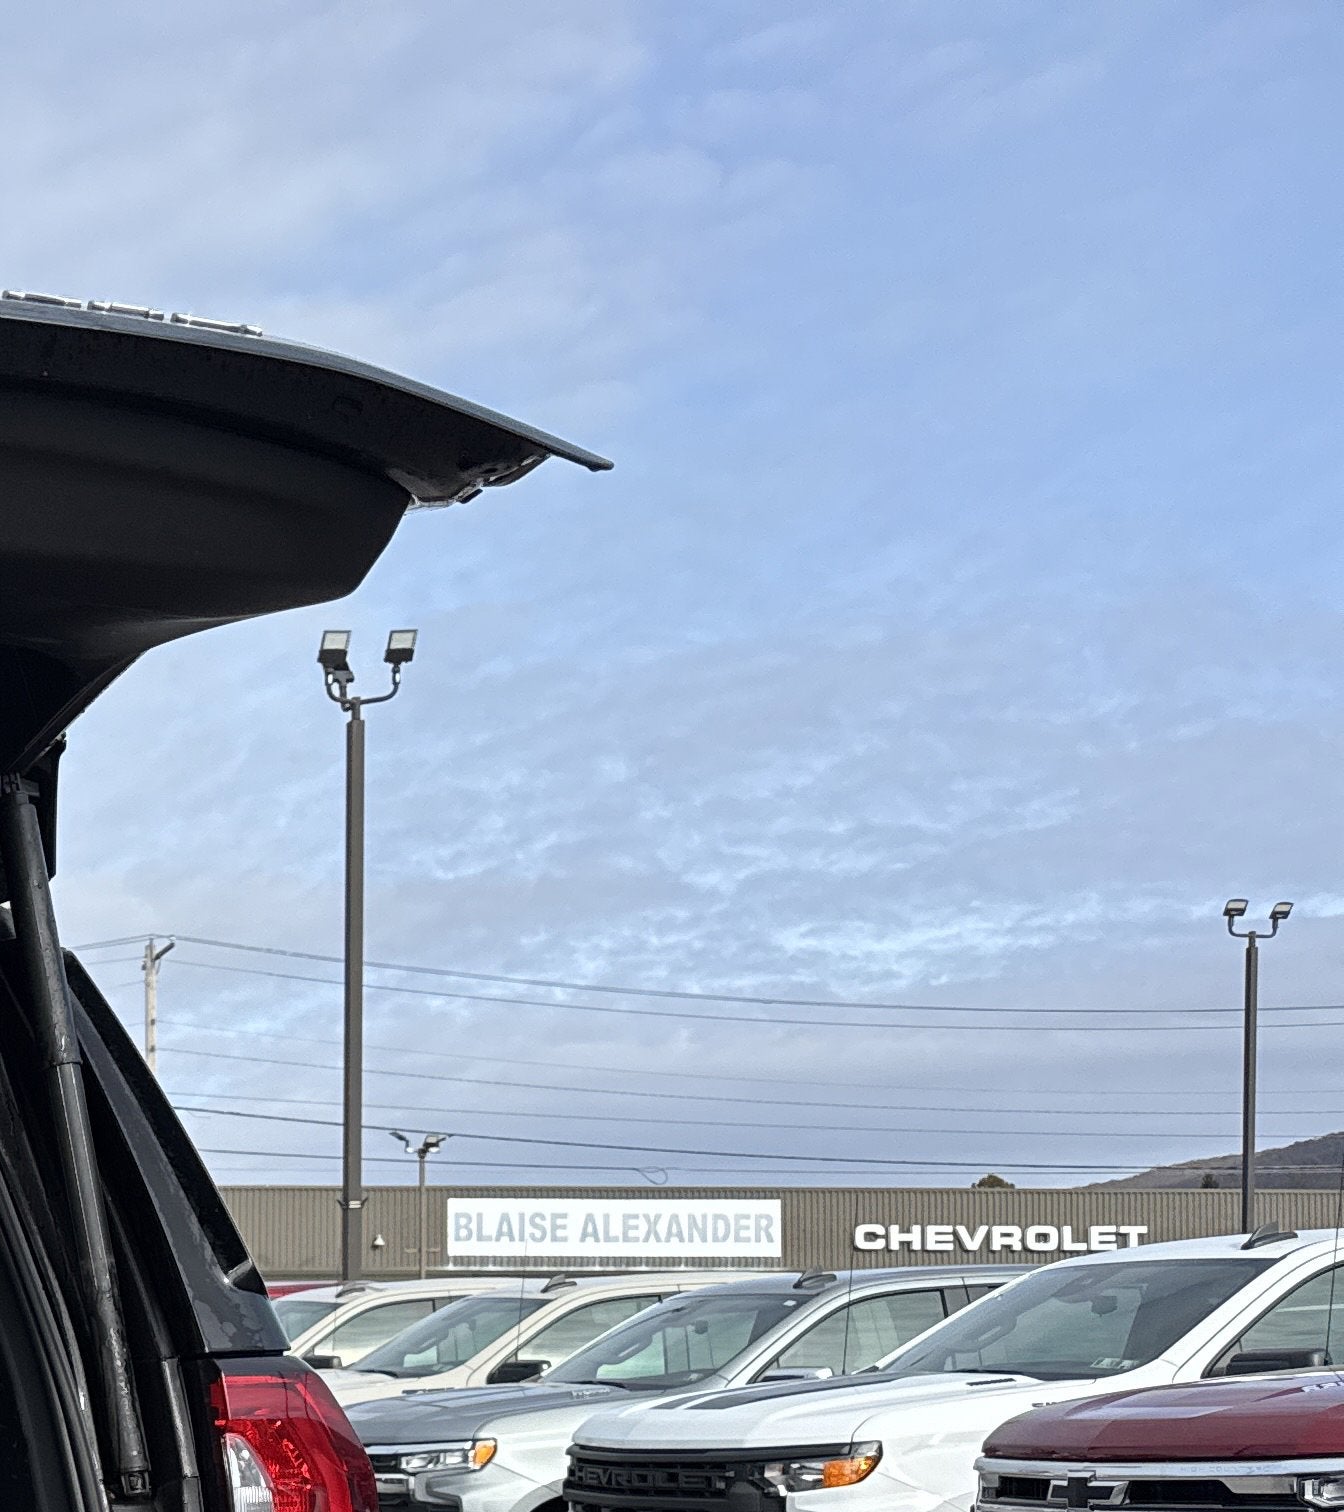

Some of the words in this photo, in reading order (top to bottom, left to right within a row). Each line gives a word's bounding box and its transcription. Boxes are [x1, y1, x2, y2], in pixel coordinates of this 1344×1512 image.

[453, 1211, 569, 1244] BLAISE
[579, 1212, 776, 1244] ALEXANDER
[854, 1223, 1148, 1251] CHEVROLET
